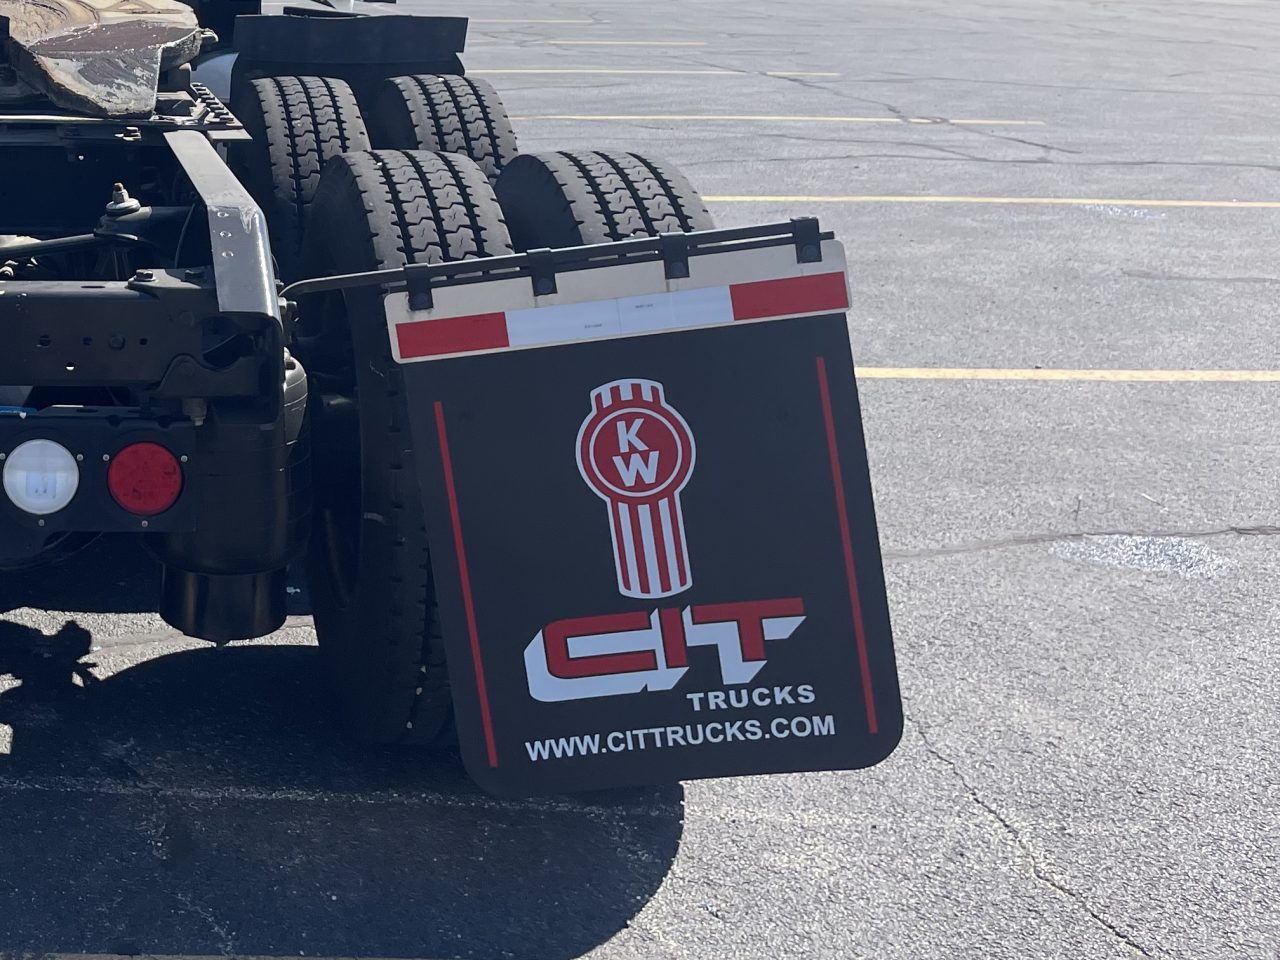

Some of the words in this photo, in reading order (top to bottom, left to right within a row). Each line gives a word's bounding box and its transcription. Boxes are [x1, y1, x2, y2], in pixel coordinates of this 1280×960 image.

[523, 598, 807, 702] CIT
[687, 685, 815, 711] TRUCKS
[524, 716, 835, 761] WWW.CITTRUCKS.COM
